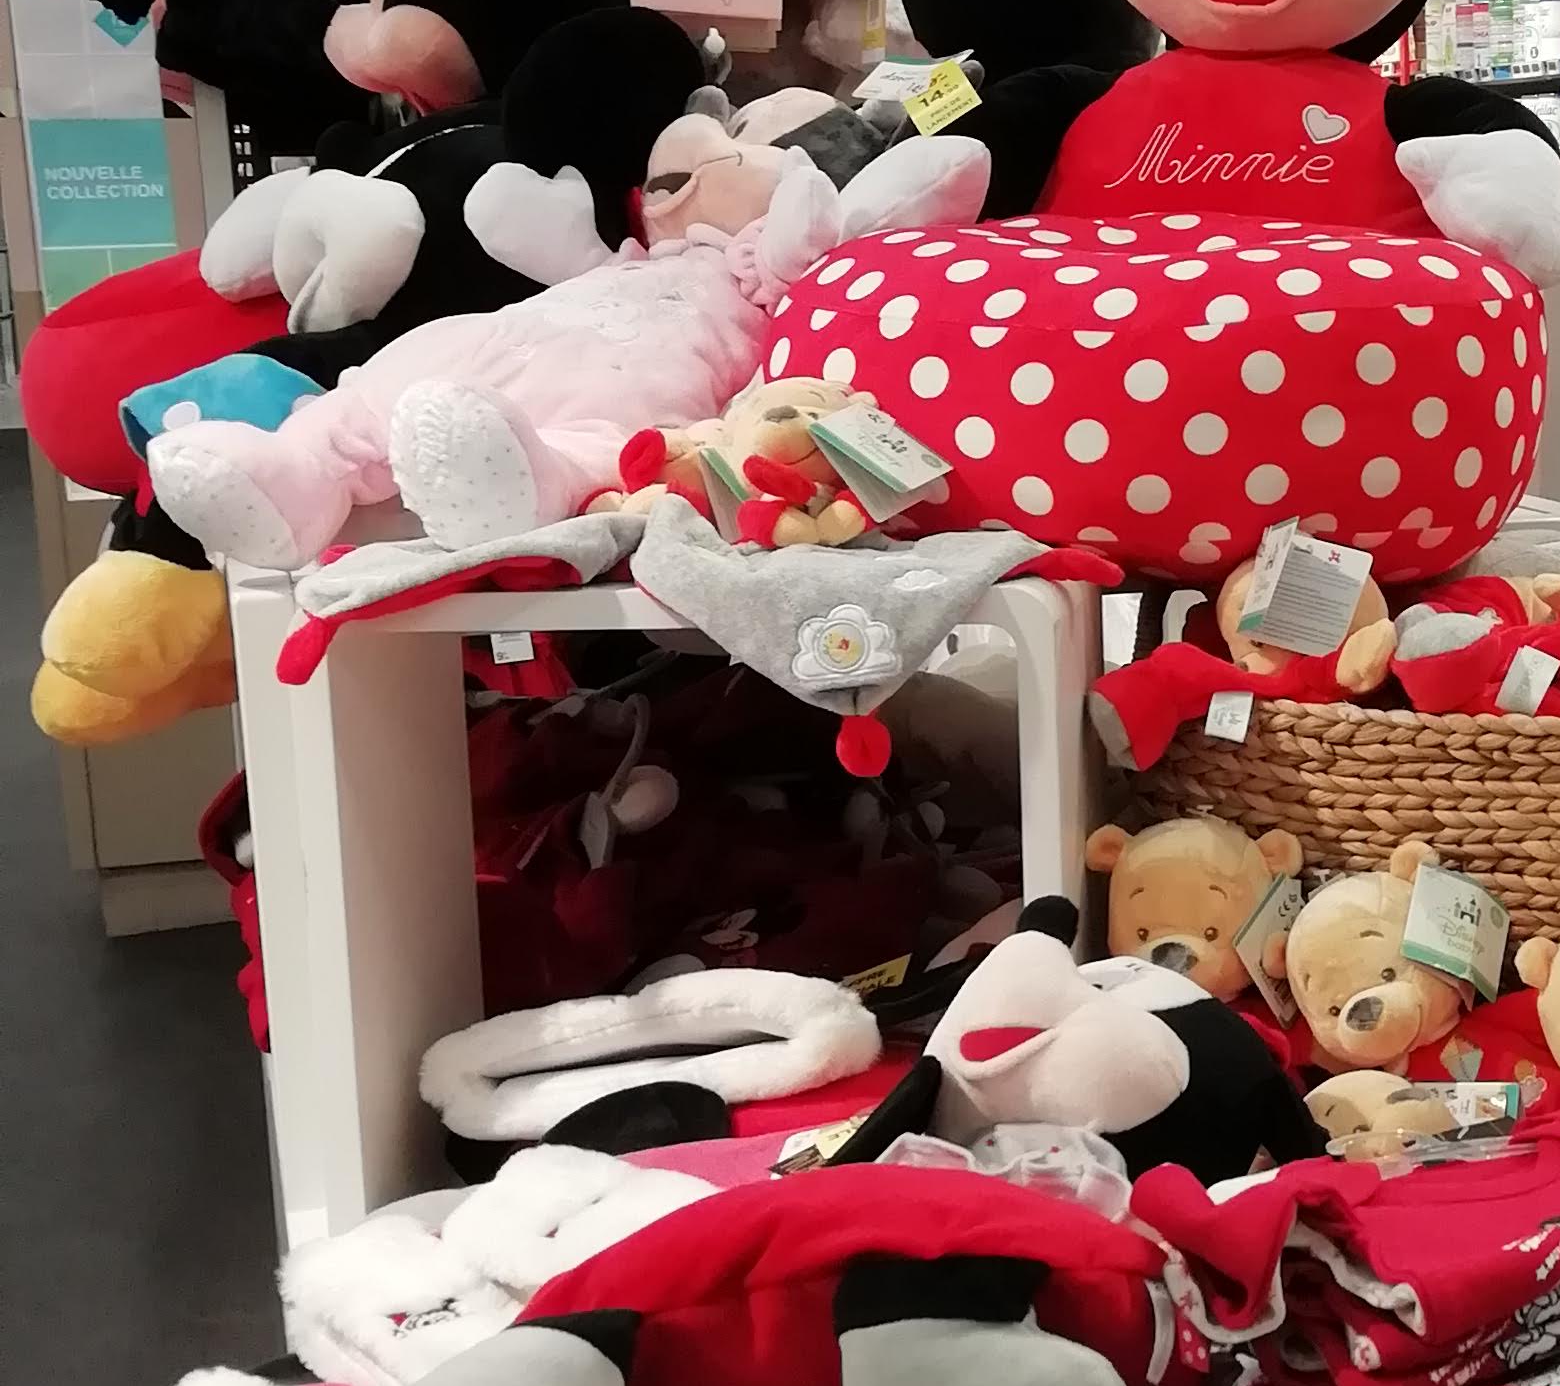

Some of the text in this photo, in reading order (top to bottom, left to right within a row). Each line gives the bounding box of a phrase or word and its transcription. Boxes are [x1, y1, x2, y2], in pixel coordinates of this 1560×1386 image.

[1104, 121, 1334, 188] Minnie
[44, 166, 143, 181] NOUVELLE
[46, 184, 164, 200] COLLECTION
